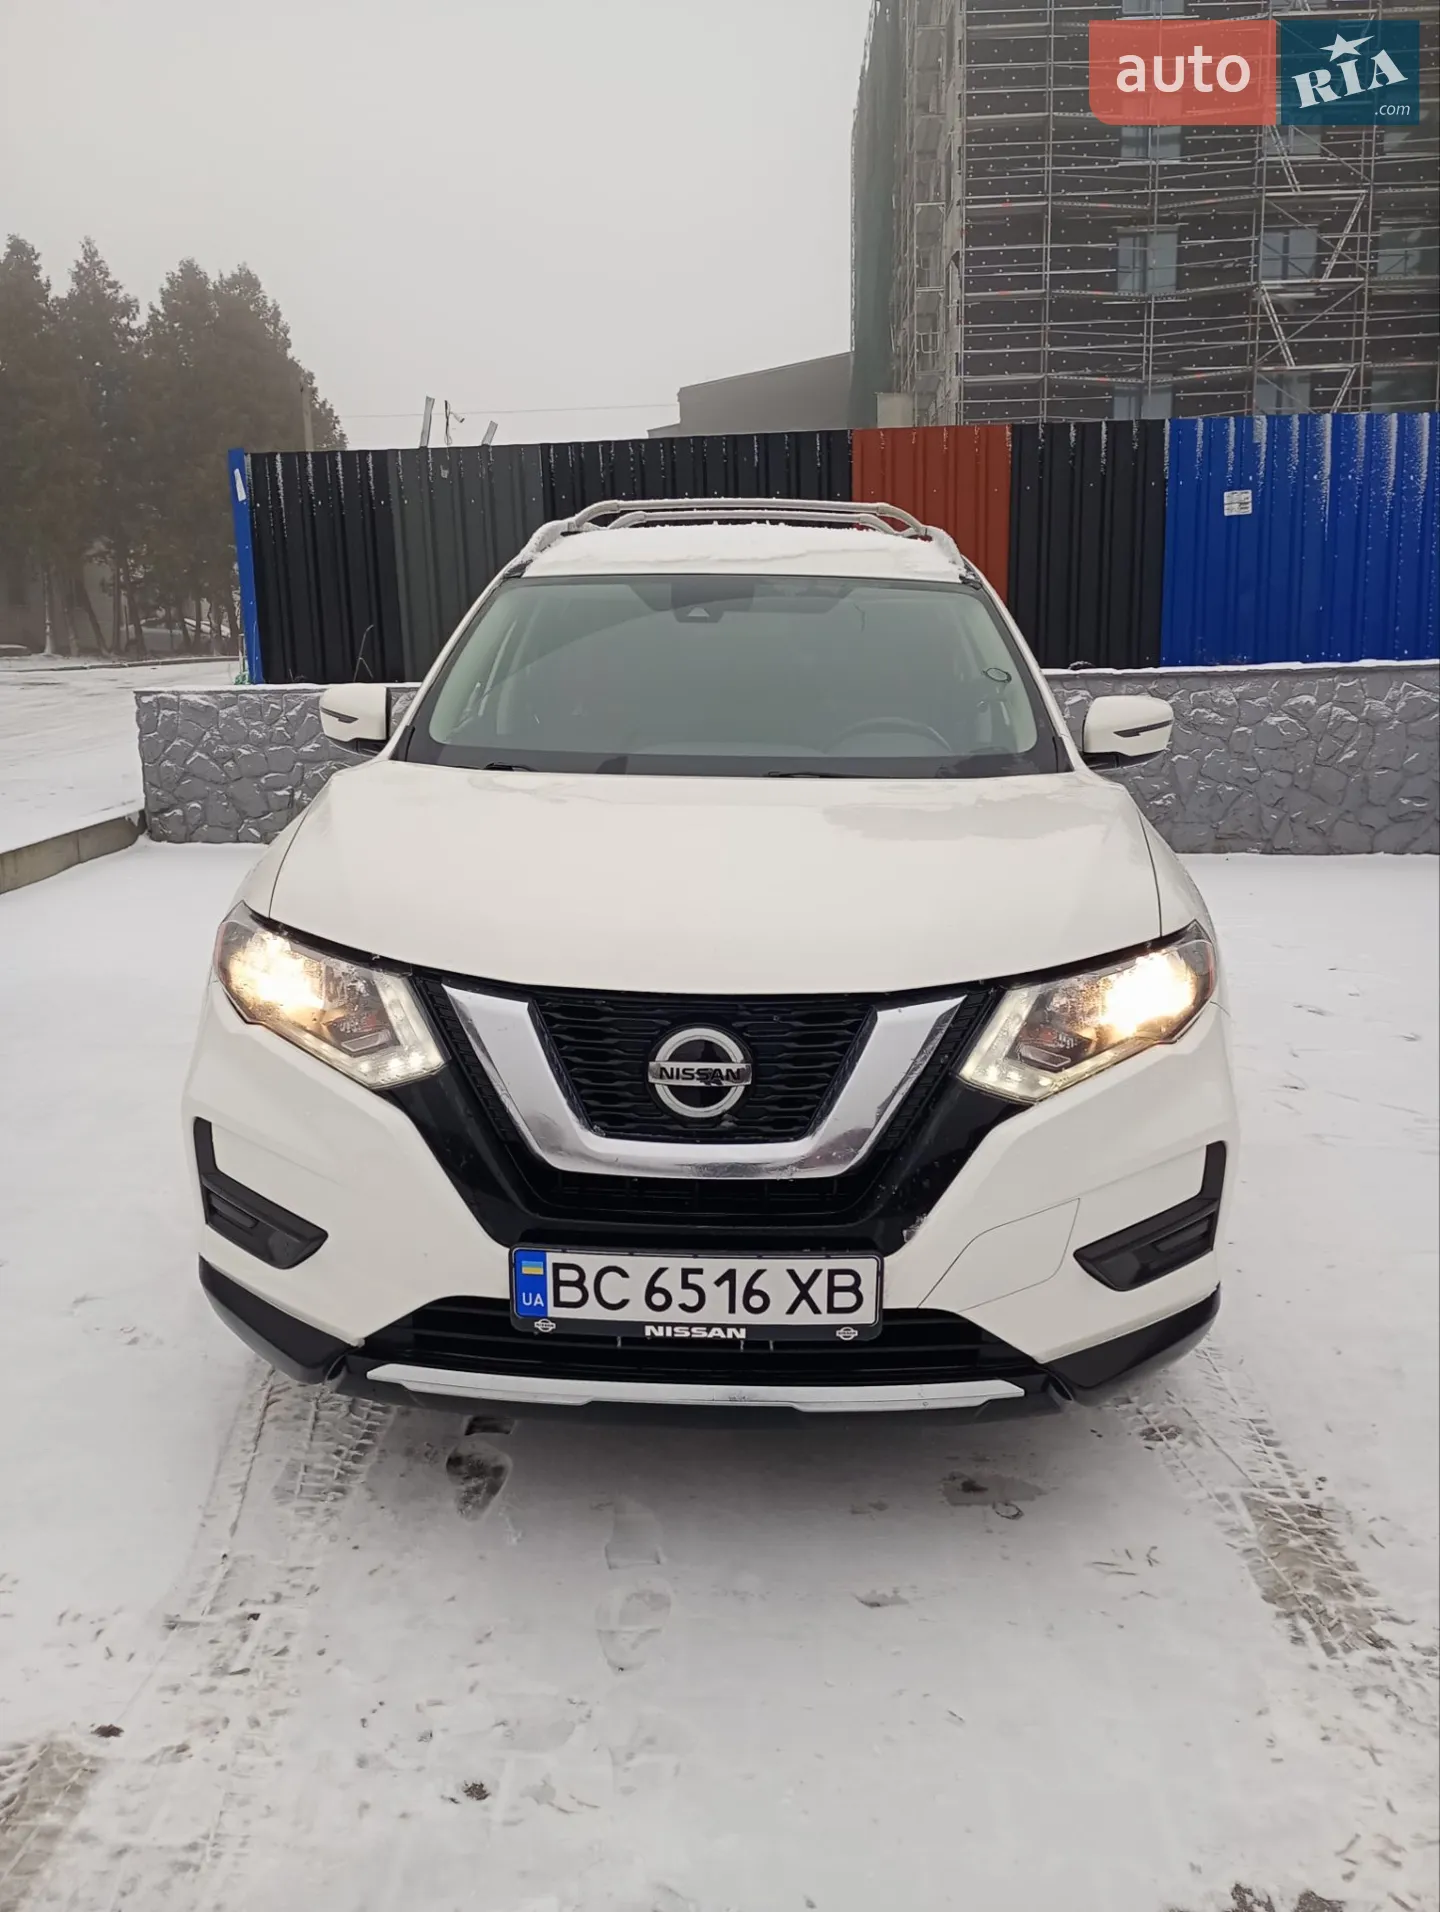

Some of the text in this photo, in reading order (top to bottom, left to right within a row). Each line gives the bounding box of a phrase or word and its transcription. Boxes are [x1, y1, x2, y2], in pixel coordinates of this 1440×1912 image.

[659, 1066, 741, 1081] NISSAN
[551, 1262, 864, 1315] BC 6516 XB
[522, 1292, 545, 1307] UA
[644, 1325, 747, 1339] NISSAN
